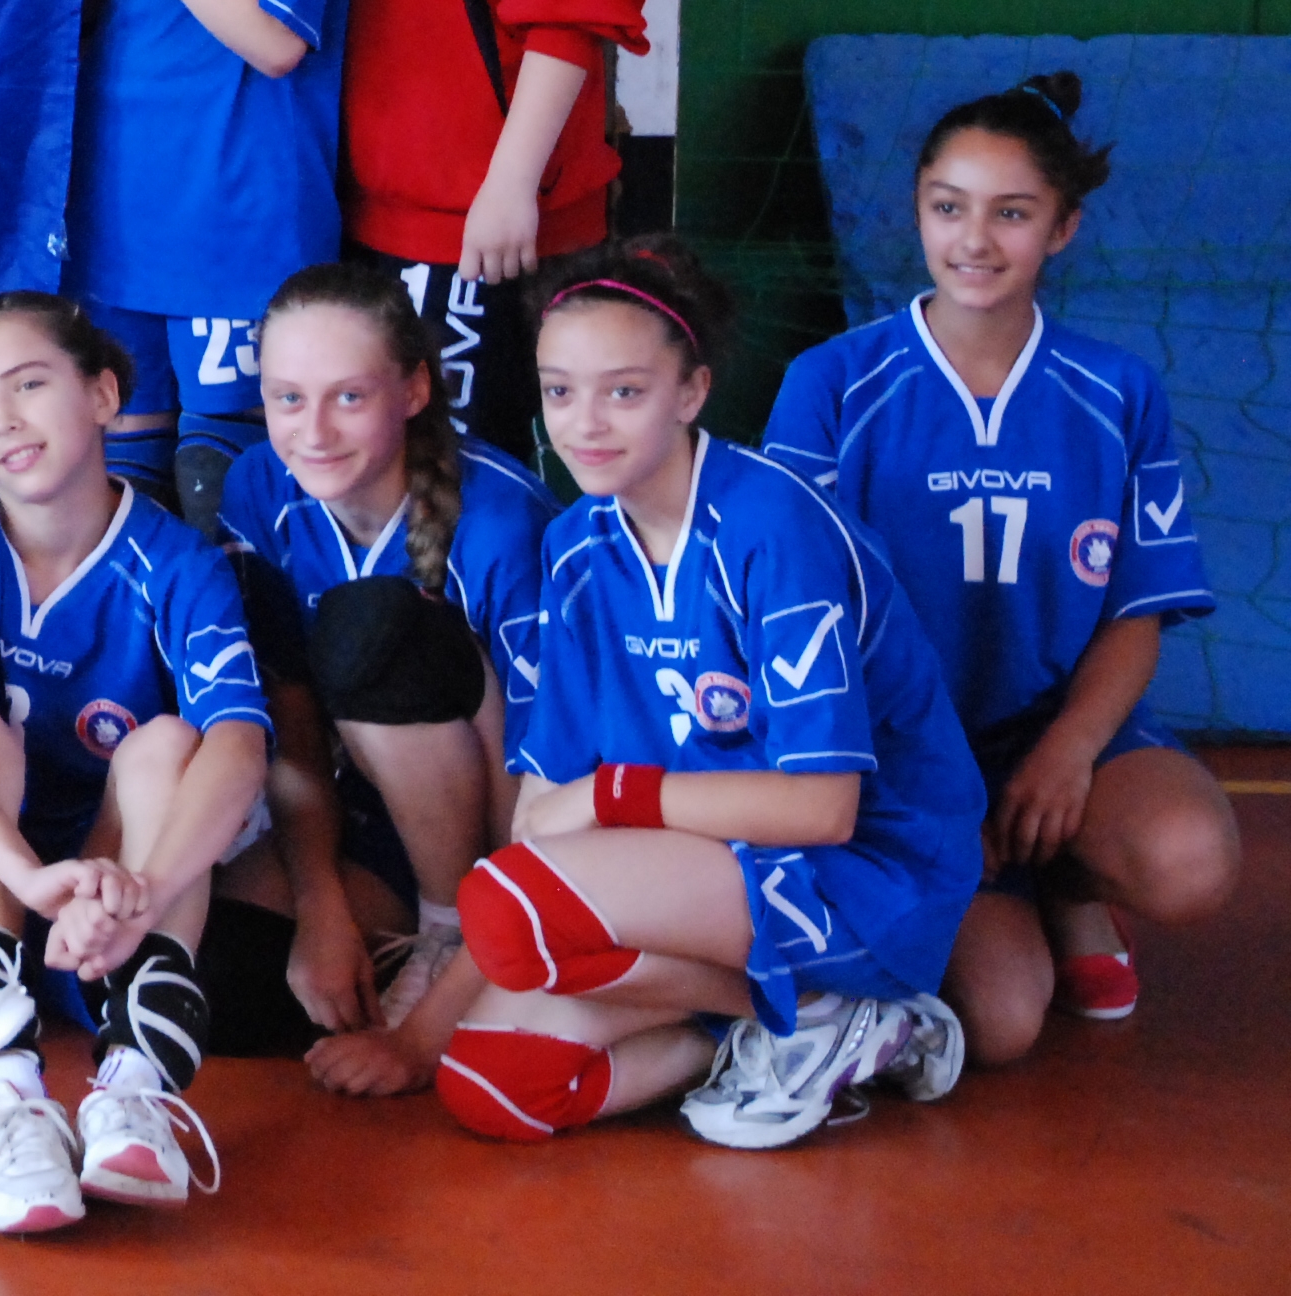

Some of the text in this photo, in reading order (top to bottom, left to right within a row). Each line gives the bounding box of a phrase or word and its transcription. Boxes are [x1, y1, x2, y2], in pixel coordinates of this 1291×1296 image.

[927, 468, 1052, 492] GIVOVA
[948, 496, 1029, 585] 17
[0, 638, 74, 679] VOVA
